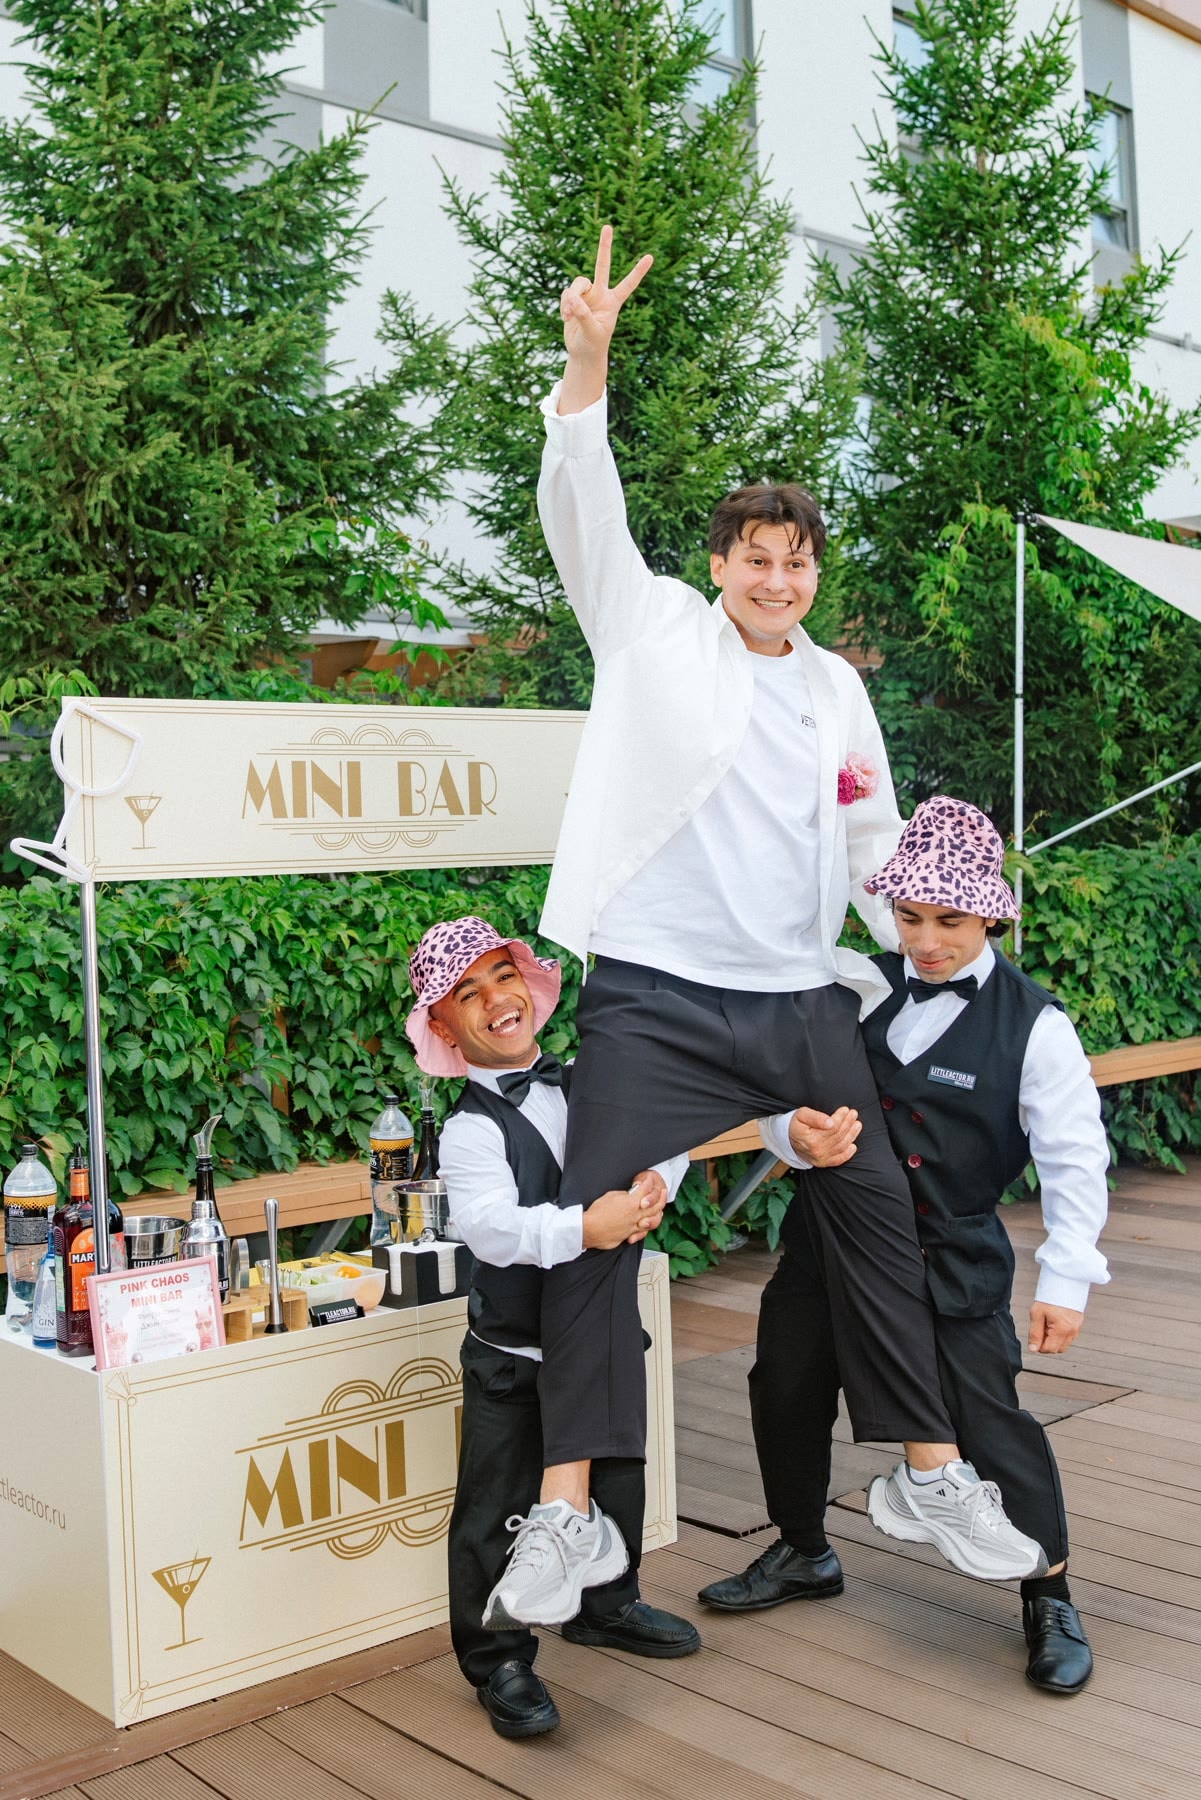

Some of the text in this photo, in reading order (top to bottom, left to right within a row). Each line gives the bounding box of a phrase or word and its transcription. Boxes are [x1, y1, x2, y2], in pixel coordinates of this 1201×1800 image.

[242, 758, 497, 819] MINI BAR
[72, 1252, 96, 1263] MAR
[120, 1273, 190, 1294] PINK CHAOS
[131, 1290, 183, 1308] MINI BAR
[38, 1318, 55, 1326] GIN
[239, 1419, 407, 1541] MINI
